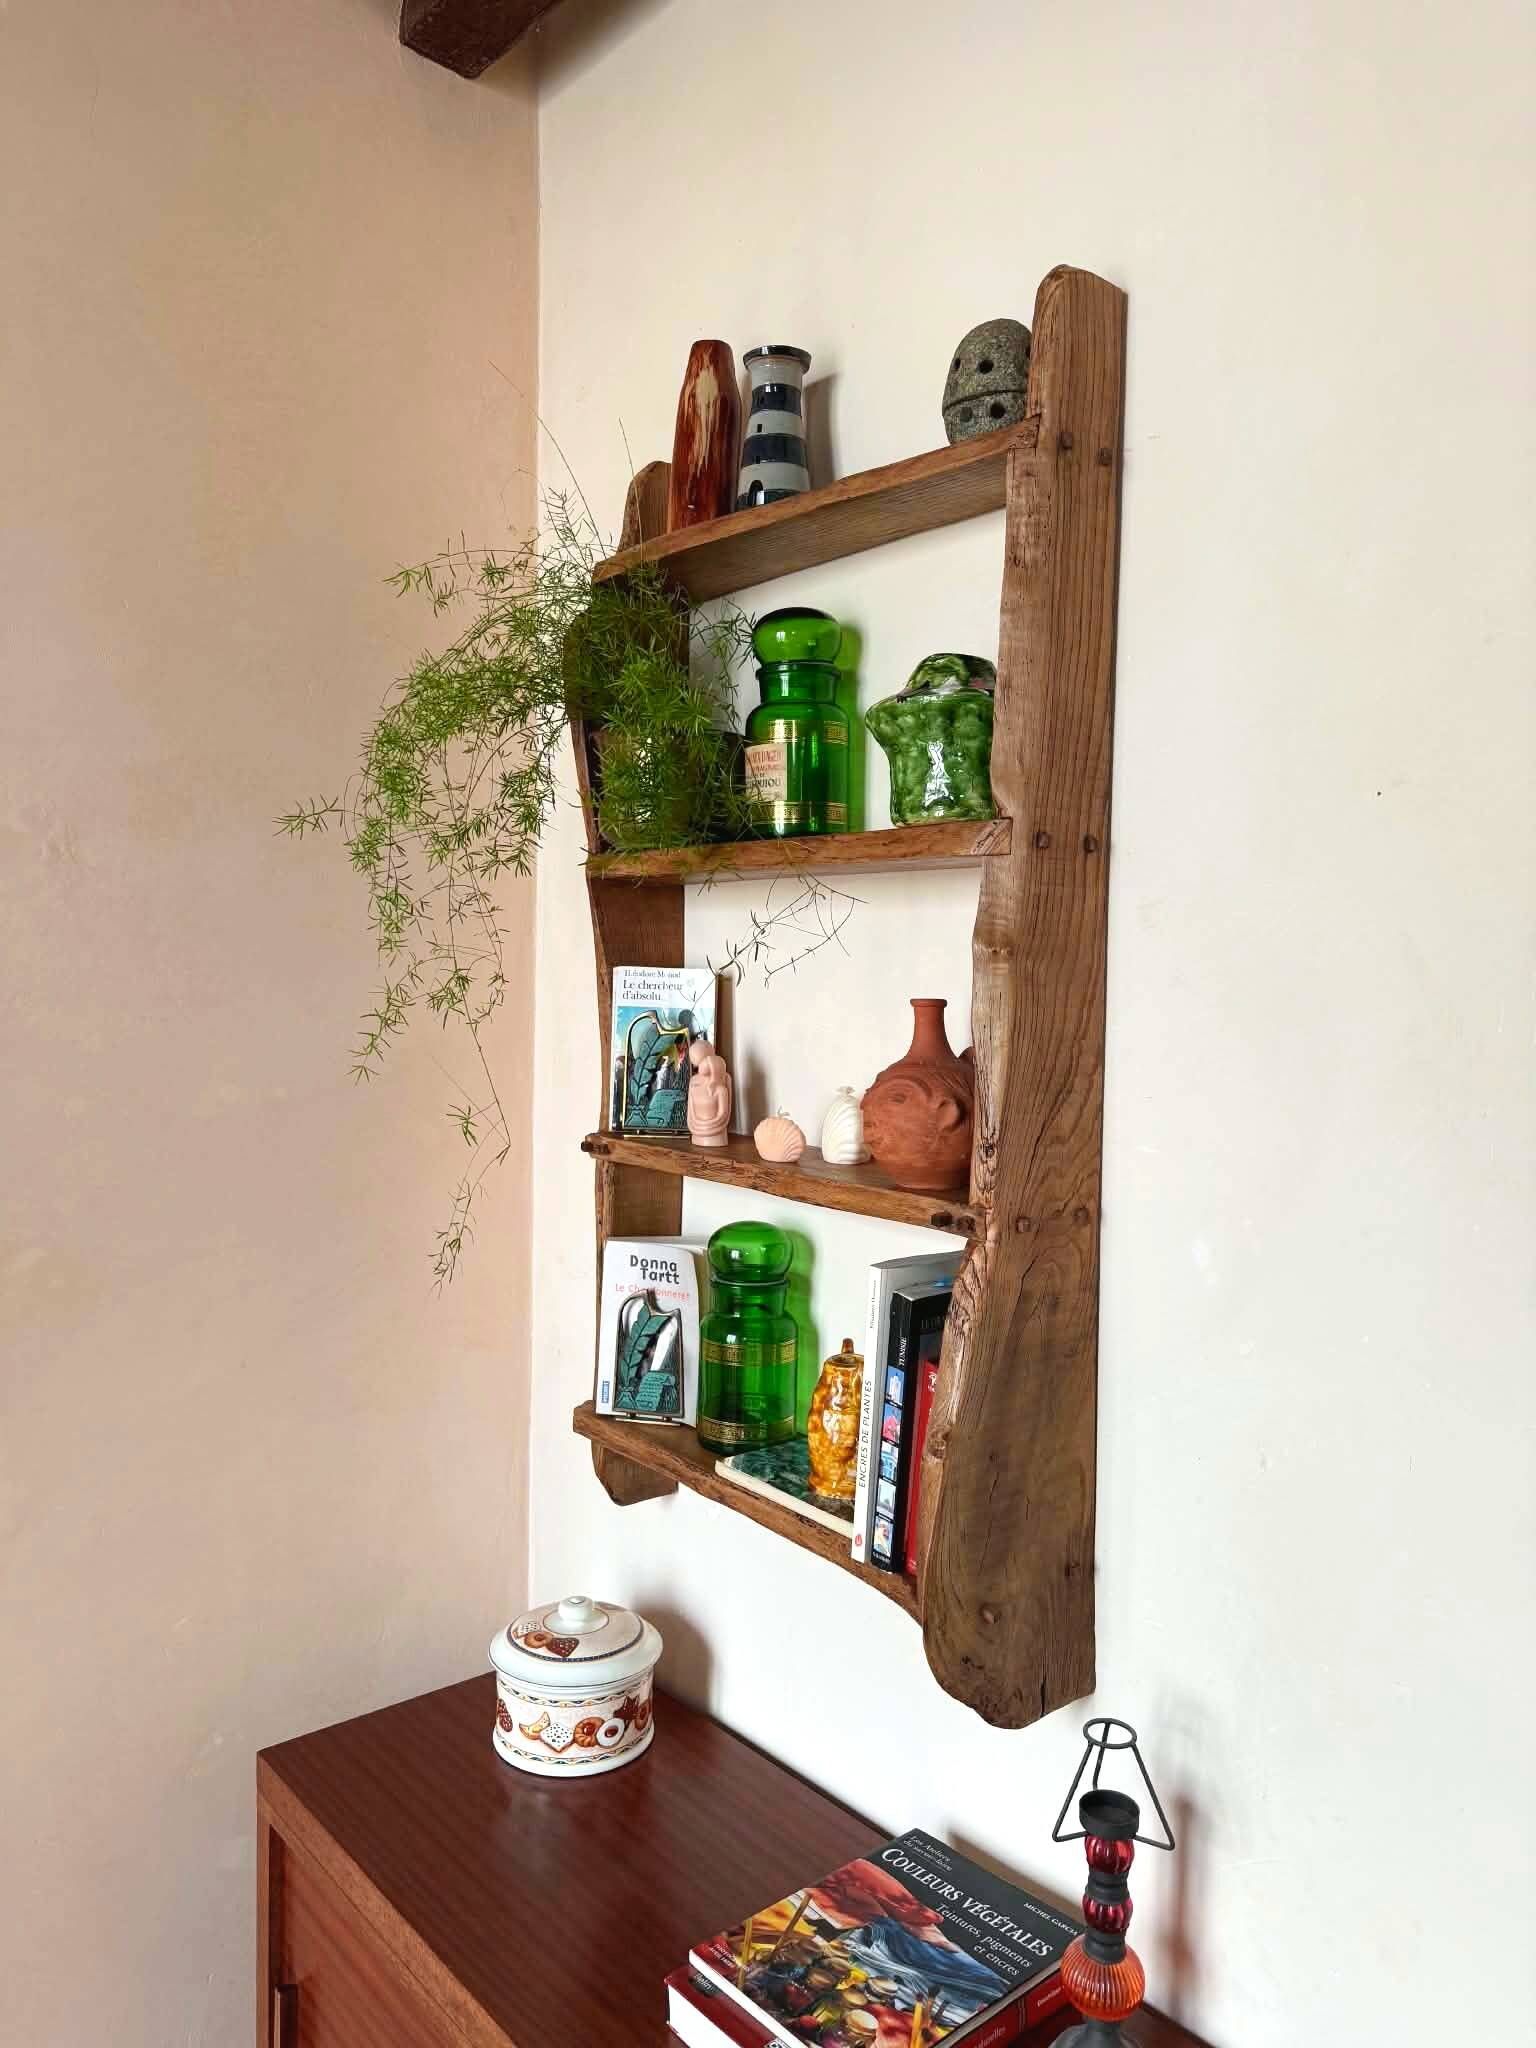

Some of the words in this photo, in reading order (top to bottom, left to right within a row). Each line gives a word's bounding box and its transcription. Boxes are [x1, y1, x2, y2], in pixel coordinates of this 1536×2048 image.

[623, 979, 635, 989] Le
[637, 979, 684, 991] chercheur
[630, 1254, 677, 1272] Donna
[640, 1267, 680, 1285] Tartt
[615, 1283, 625, 1292] Le
[862, 1380, 872, 1427] PLANTES
[861, 1430, 870, 1446] DE
[859, 1447, 868, 1488] ENCRES
[881, 1848, 964, 1901] COULEURS
[962, 1897, 1053, 1957] VÉGÉTALES
[1023, 1902, 1051, 1920] MICHEL
[937, 1902, 981, 1938] Teintures,
[980, 1936, 1033, 1968] pigments
[973, 1944, 986, 1954] et
[985, 1952, 1020, 1976] encres
